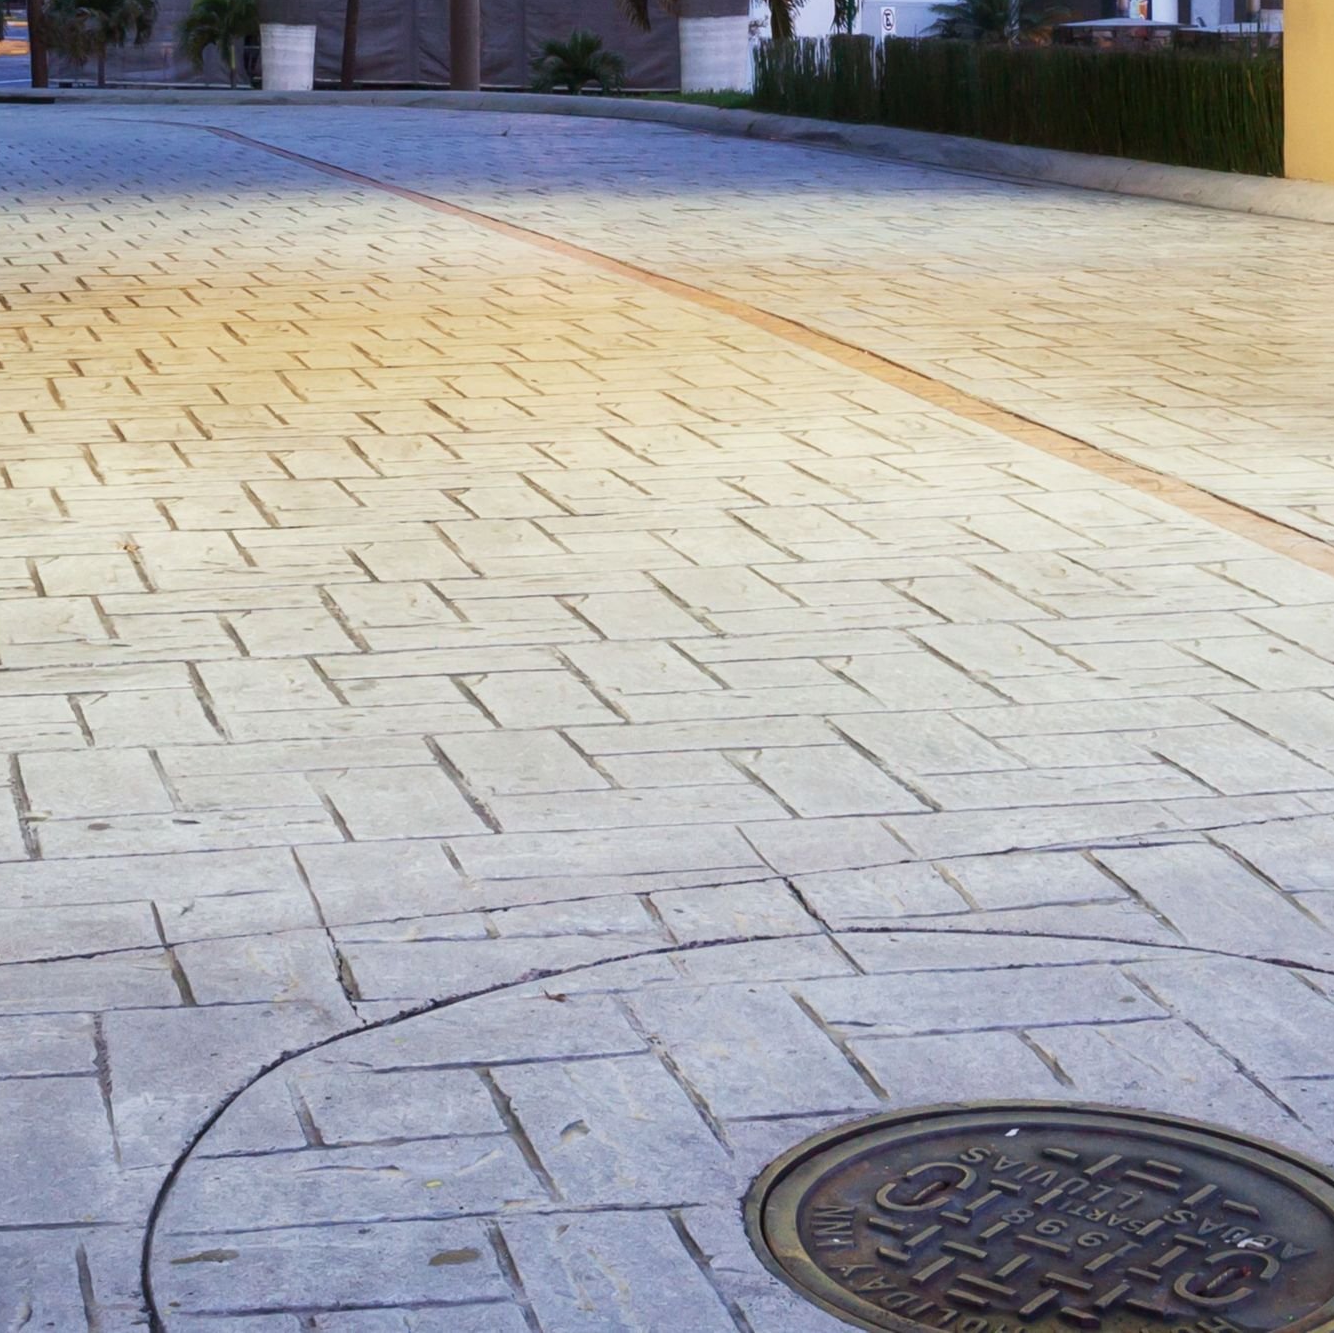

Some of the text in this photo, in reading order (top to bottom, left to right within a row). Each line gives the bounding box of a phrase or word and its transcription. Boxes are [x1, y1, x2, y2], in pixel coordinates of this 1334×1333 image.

[813, 1204, 857, 1249] INN
[959, 1146, 1316, 1260] AGUAS LLUVIAS
[1000, 1207, 1142, 1256] 1998
